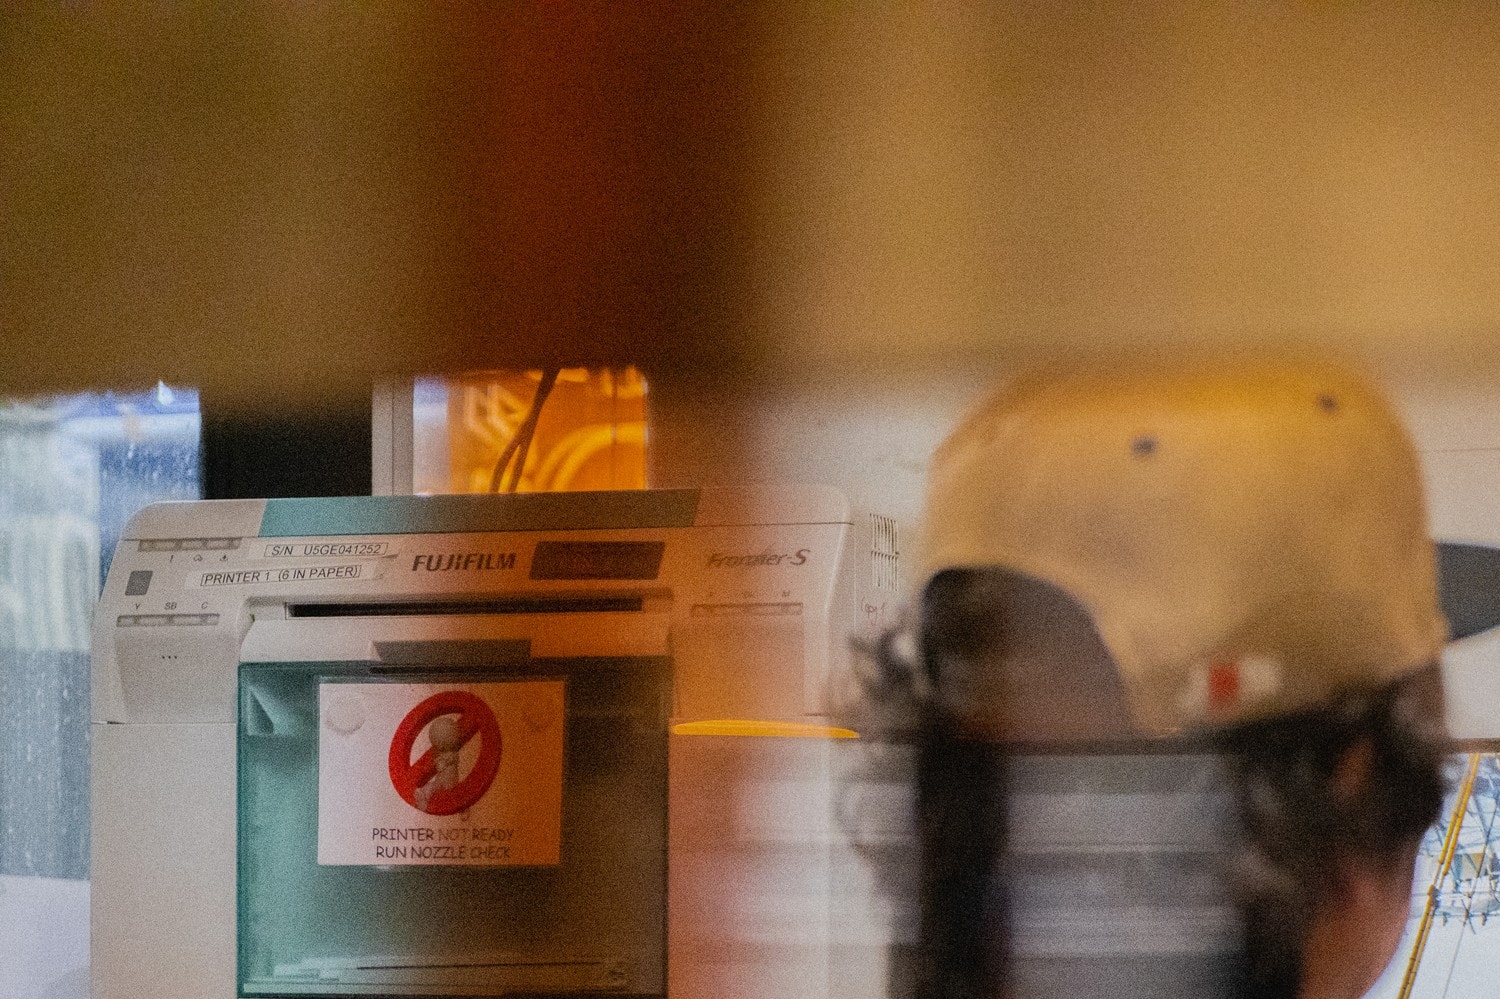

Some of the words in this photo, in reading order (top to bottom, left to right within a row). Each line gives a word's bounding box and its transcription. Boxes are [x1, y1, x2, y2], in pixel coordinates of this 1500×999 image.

[271, 544, 294, 556] S/N
[412, 554, 517, 572] FUJIFILM
[204, 570, 260, 584] PRINTER
[278, 568, 290, 582] (6
[293, 568, 306, 580] IN
[308, 566, 360, 579] PAPER)
[372, 828, 434, 842] PRINTER
[438, 828, 468, 841] NOT
[472, 828, 514, 841] READY
[376, 846, 407, 859] RUN
[411, 846, 466, 860] NOZZLE
[470, 846, 512, 860] CHECK
